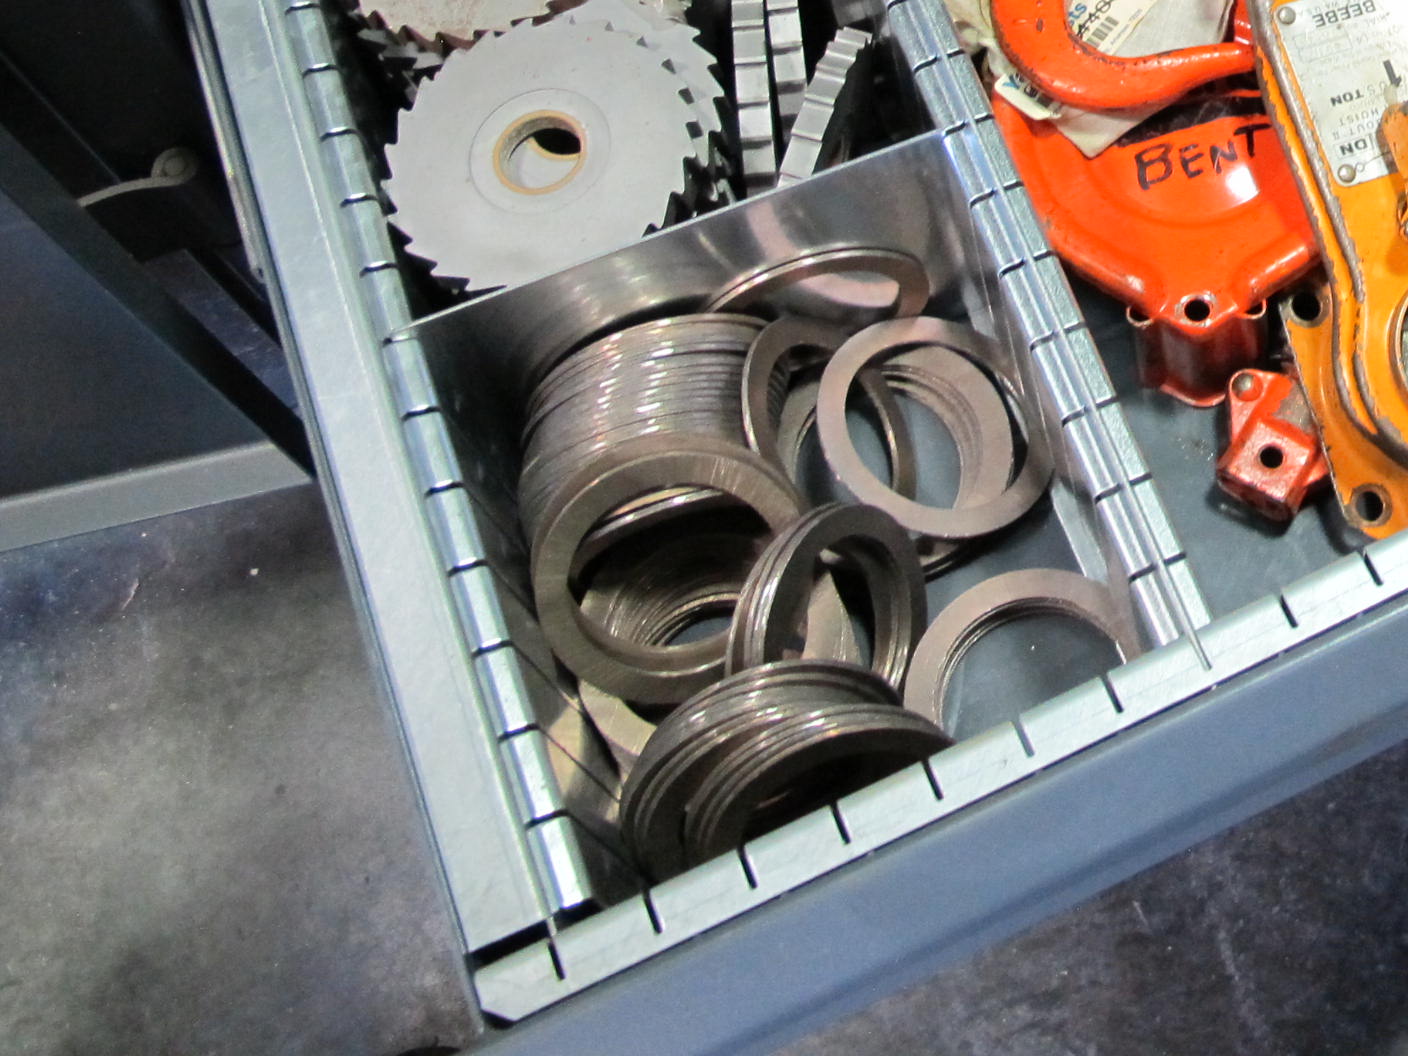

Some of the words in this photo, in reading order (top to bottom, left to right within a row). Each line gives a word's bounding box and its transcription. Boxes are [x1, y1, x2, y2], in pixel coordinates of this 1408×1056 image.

[1313, 0, 1376, 28] BEEBE
[1383, 59, 1402, 88] 1
[1330, 90, 1365, 106] TON
[1338, 108, 1380, 127] HOIST
[1134, 122, 1273, 191] BENT
[1340, 137, 1369, 157] DN
